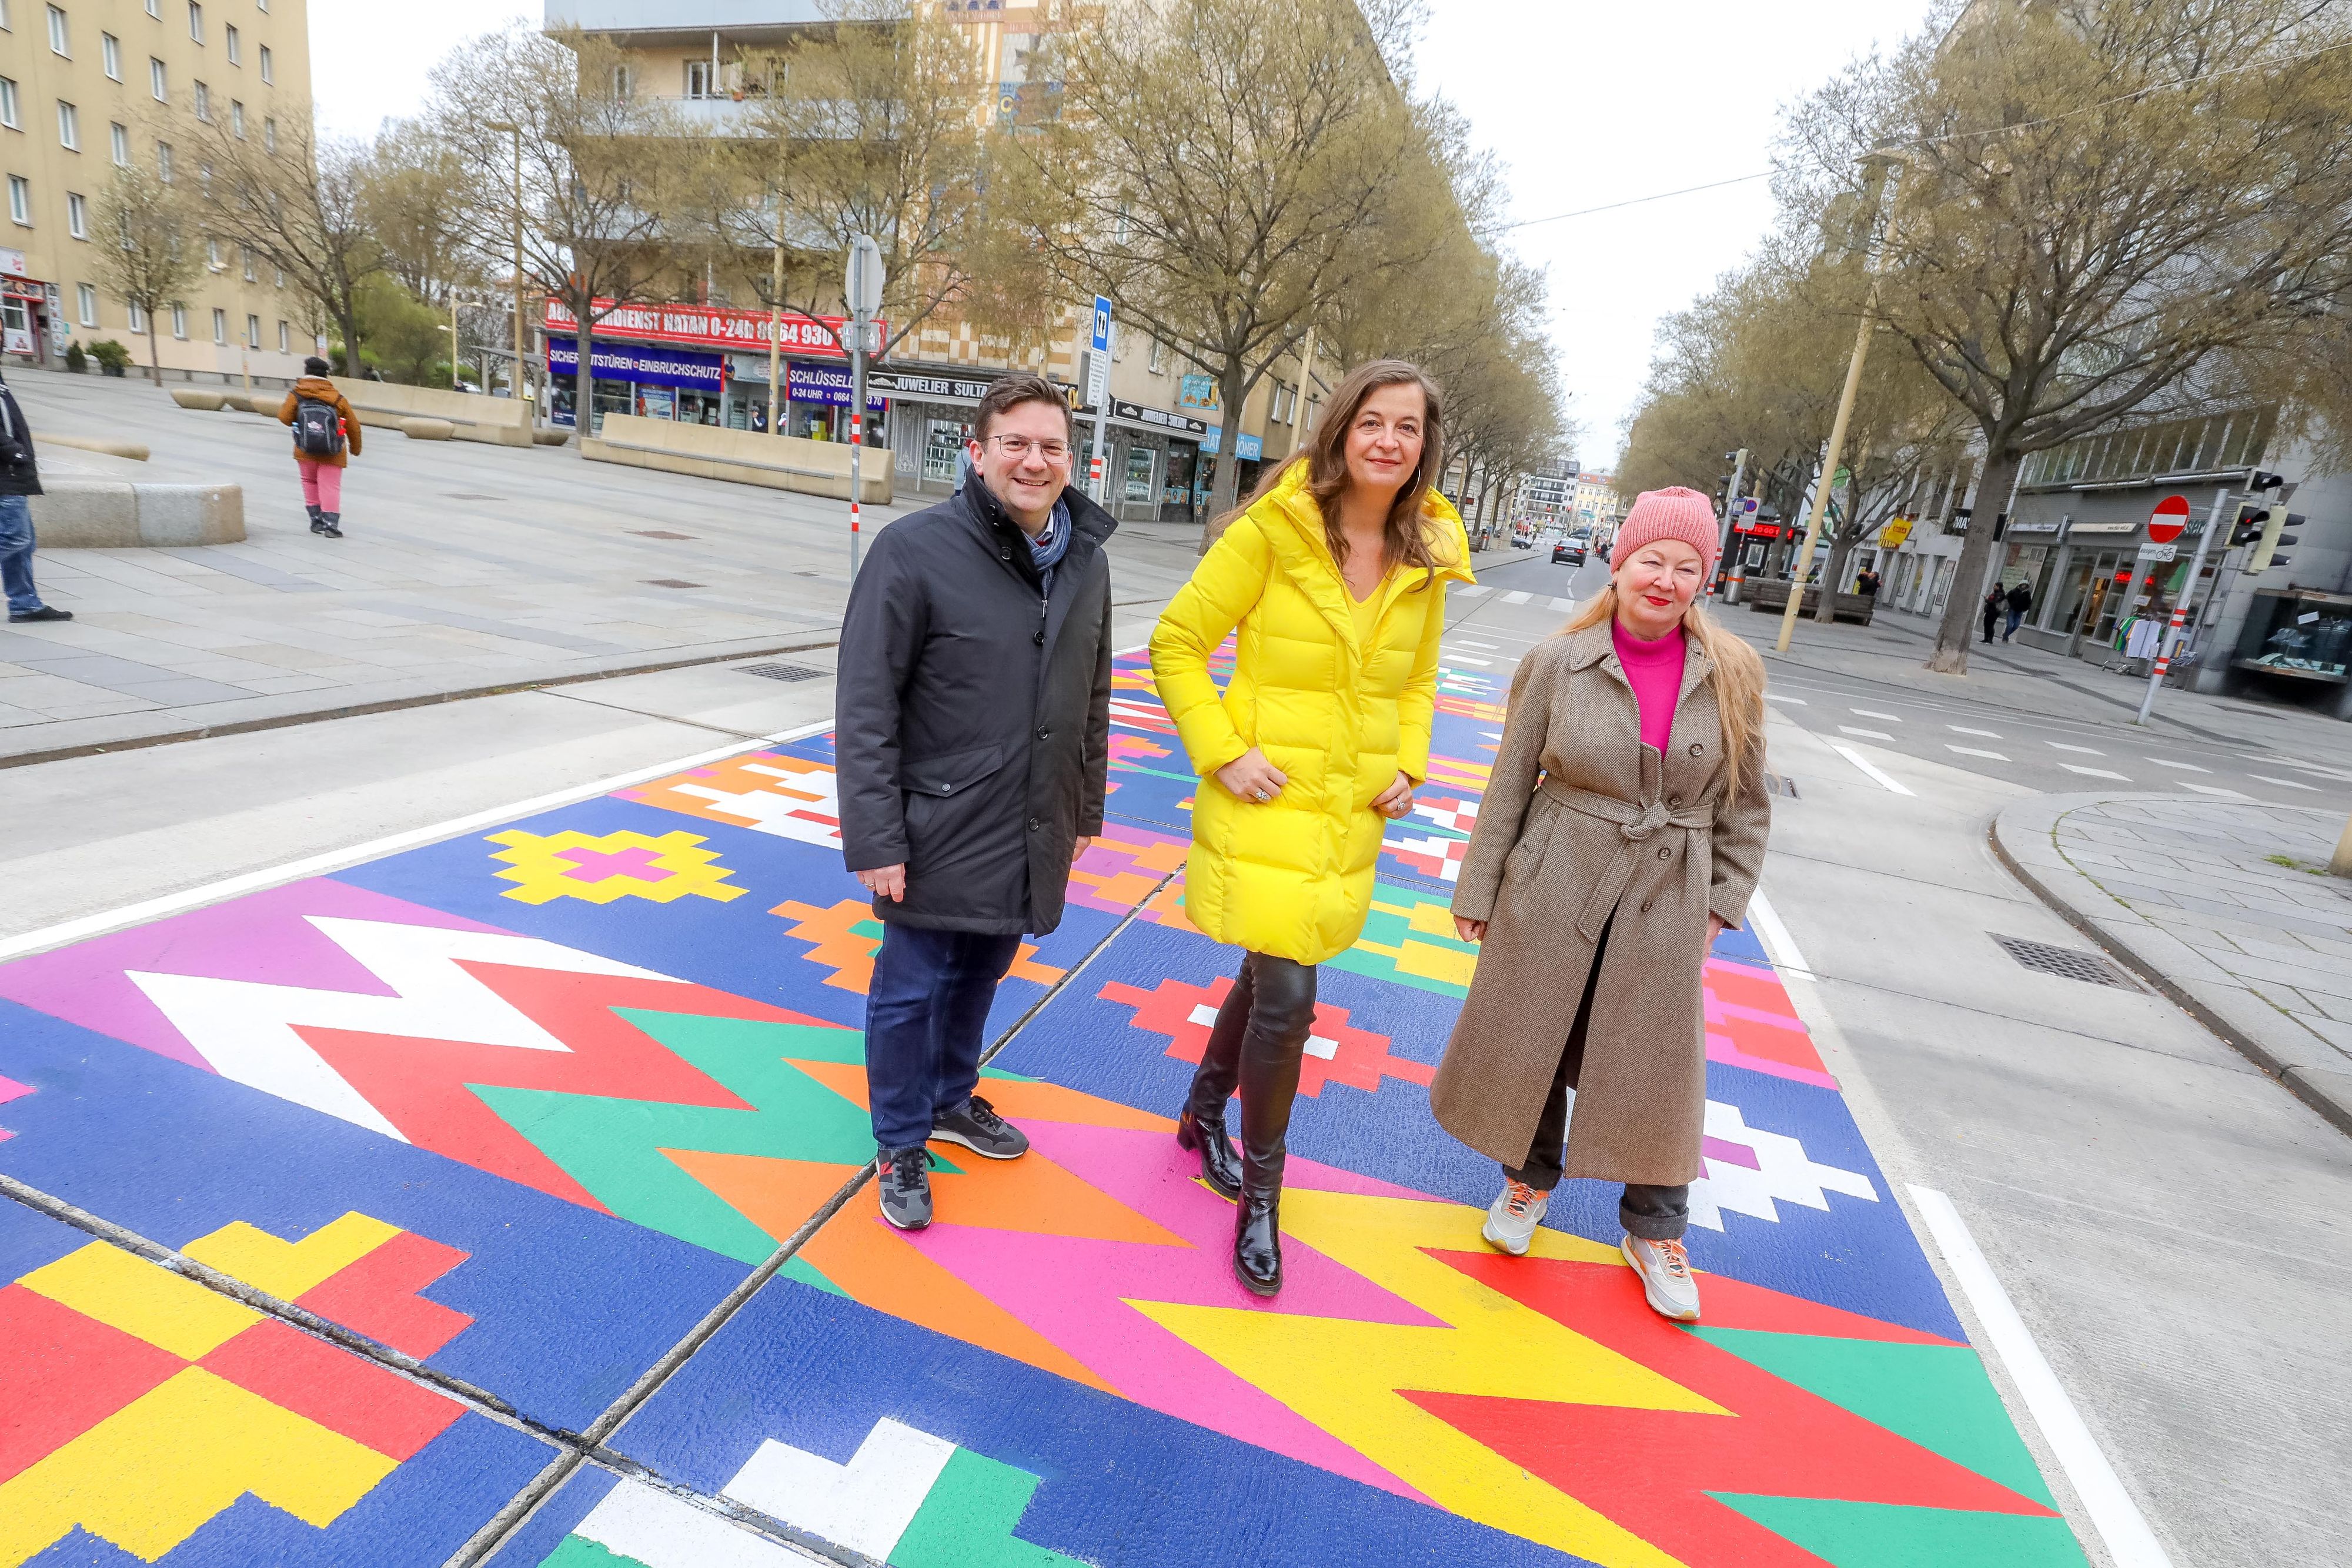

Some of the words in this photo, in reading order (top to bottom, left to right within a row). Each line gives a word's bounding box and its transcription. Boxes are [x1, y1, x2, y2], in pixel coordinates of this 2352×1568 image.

[663, 313, 708, 335] NATAN
[710, 316, 754, 339] 0-24h
[801, 324, 833, 346] 930
[549, 349, 633, 370] SICHERITSTÜREN
[639, 359, 721, 380] EINBRUCHSCHUTZ
[792, 387, 806, 397] 0-24
[807, 389, 823, 399] UHR
[833, 392, 849, 402] 0664
[874, 397, 882, 406] 70
[895, 377, 949, 394] JUWELIER
[954, 382, 988, 398] SULTA
[1236, 436, 1258, 457] ÖNER
